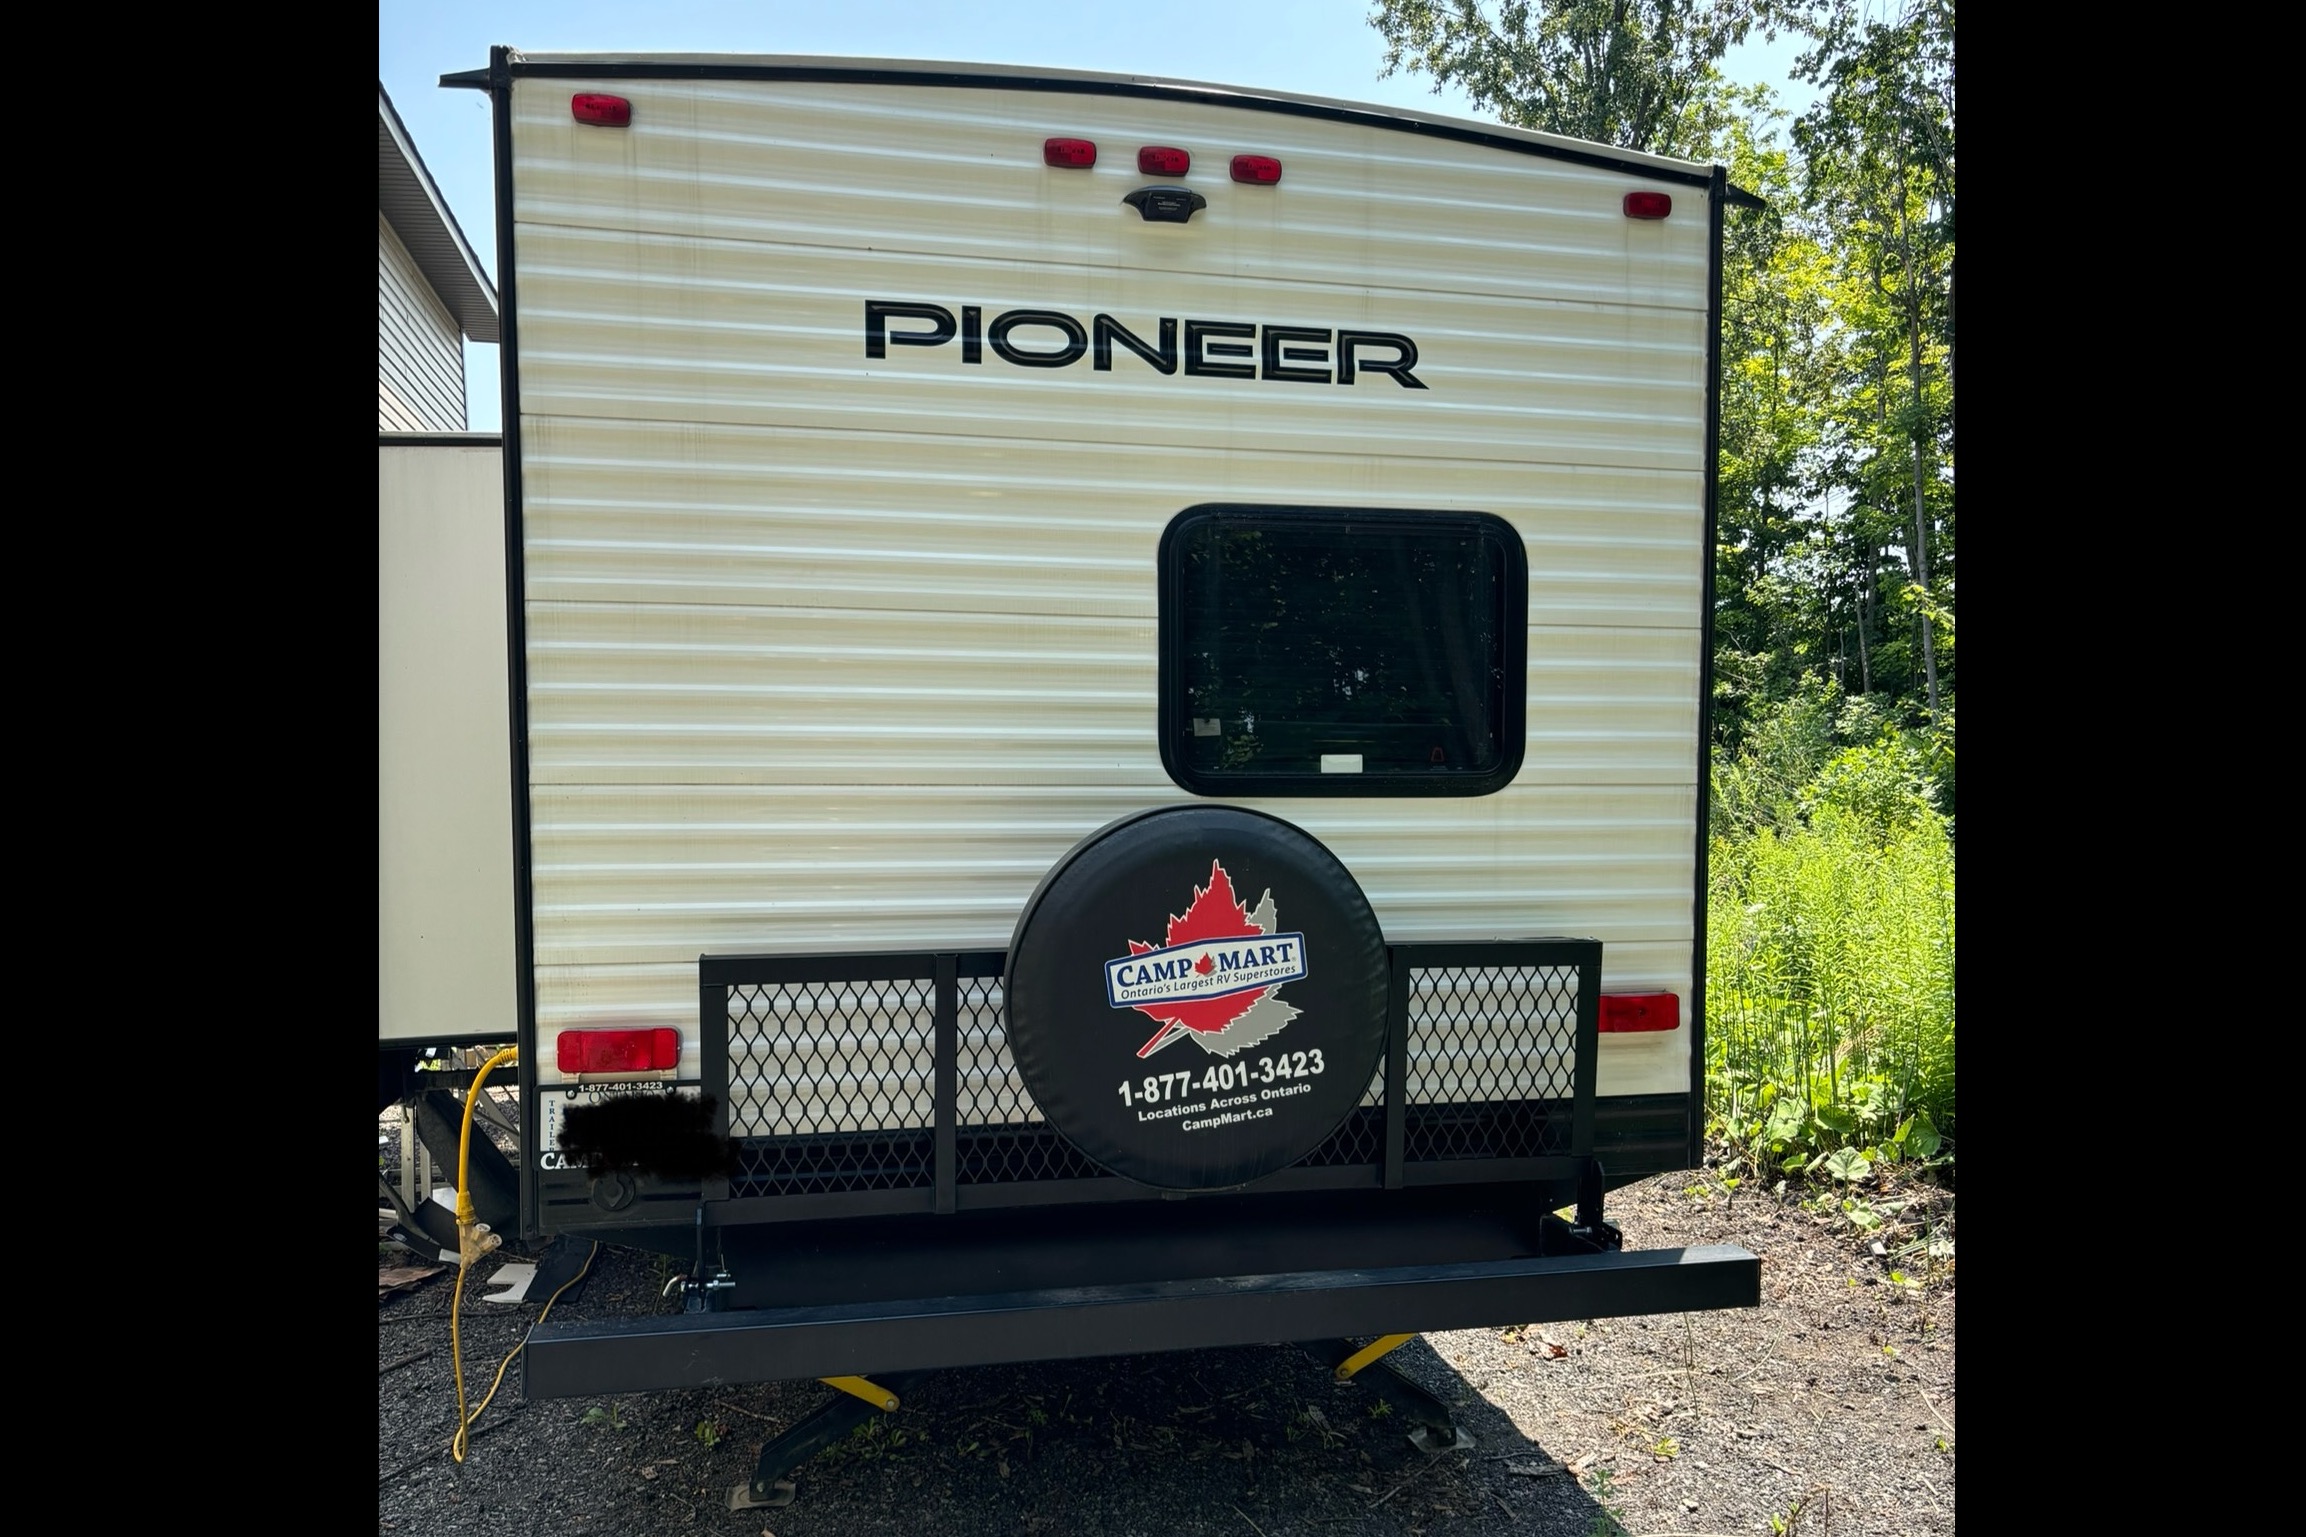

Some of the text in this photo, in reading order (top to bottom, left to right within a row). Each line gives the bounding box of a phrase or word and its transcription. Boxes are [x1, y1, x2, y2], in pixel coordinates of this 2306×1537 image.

[864, 299, 1430, 390] PIONEER
[1116, 943, 1293, 987] CAMP MART
[1121, 965, 1296, 1000] Ontario's Largest RV Superstores
[578, 1081, 663, 1092] 1-877-401-3423
[1118, 1048, 1325, 1107] 1-877-401-3423
[1138, 1082, 1311, 1122] Locations Across Ontario
[1182, 1106, 1273, 1132] CampMart.ca
